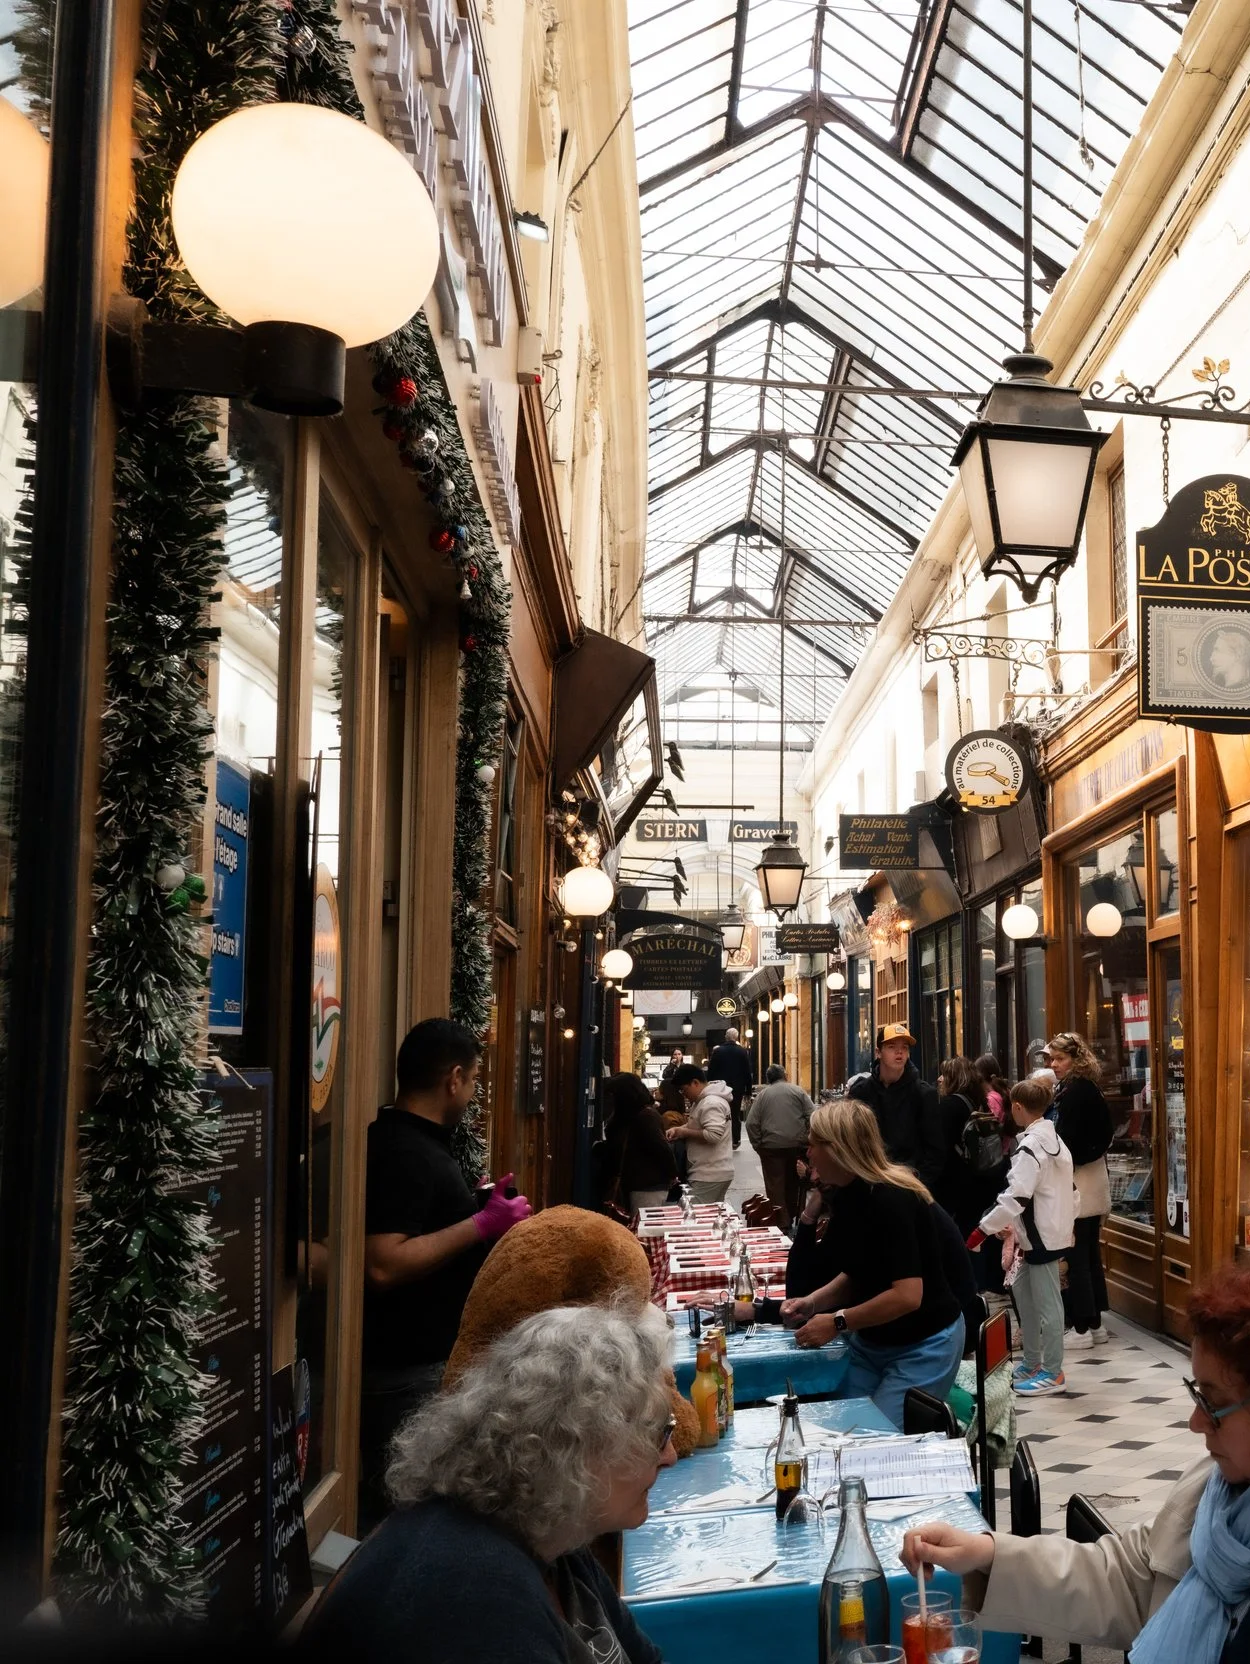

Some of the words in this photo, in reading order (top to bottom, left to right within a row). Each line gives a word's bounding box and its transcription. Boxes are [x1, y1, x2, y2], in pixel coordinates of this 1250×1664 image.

[1139, 545, 1179, 582] LA
[1176, 647, 1188, 667] 5
[982, 739, 995, 749] de
[955, 741, 980, 777] matériel
[995, 743, 1019, 790] collections
[956, 779, 965, 790] au
[982, 795, 996, 805] 54
[215, 802, 232, 829] rand
[643, 822, 700, 839] STERN
[844, 844, 904, 854] Estimation
[631, 936, 717, 957] MARÉCHAL
